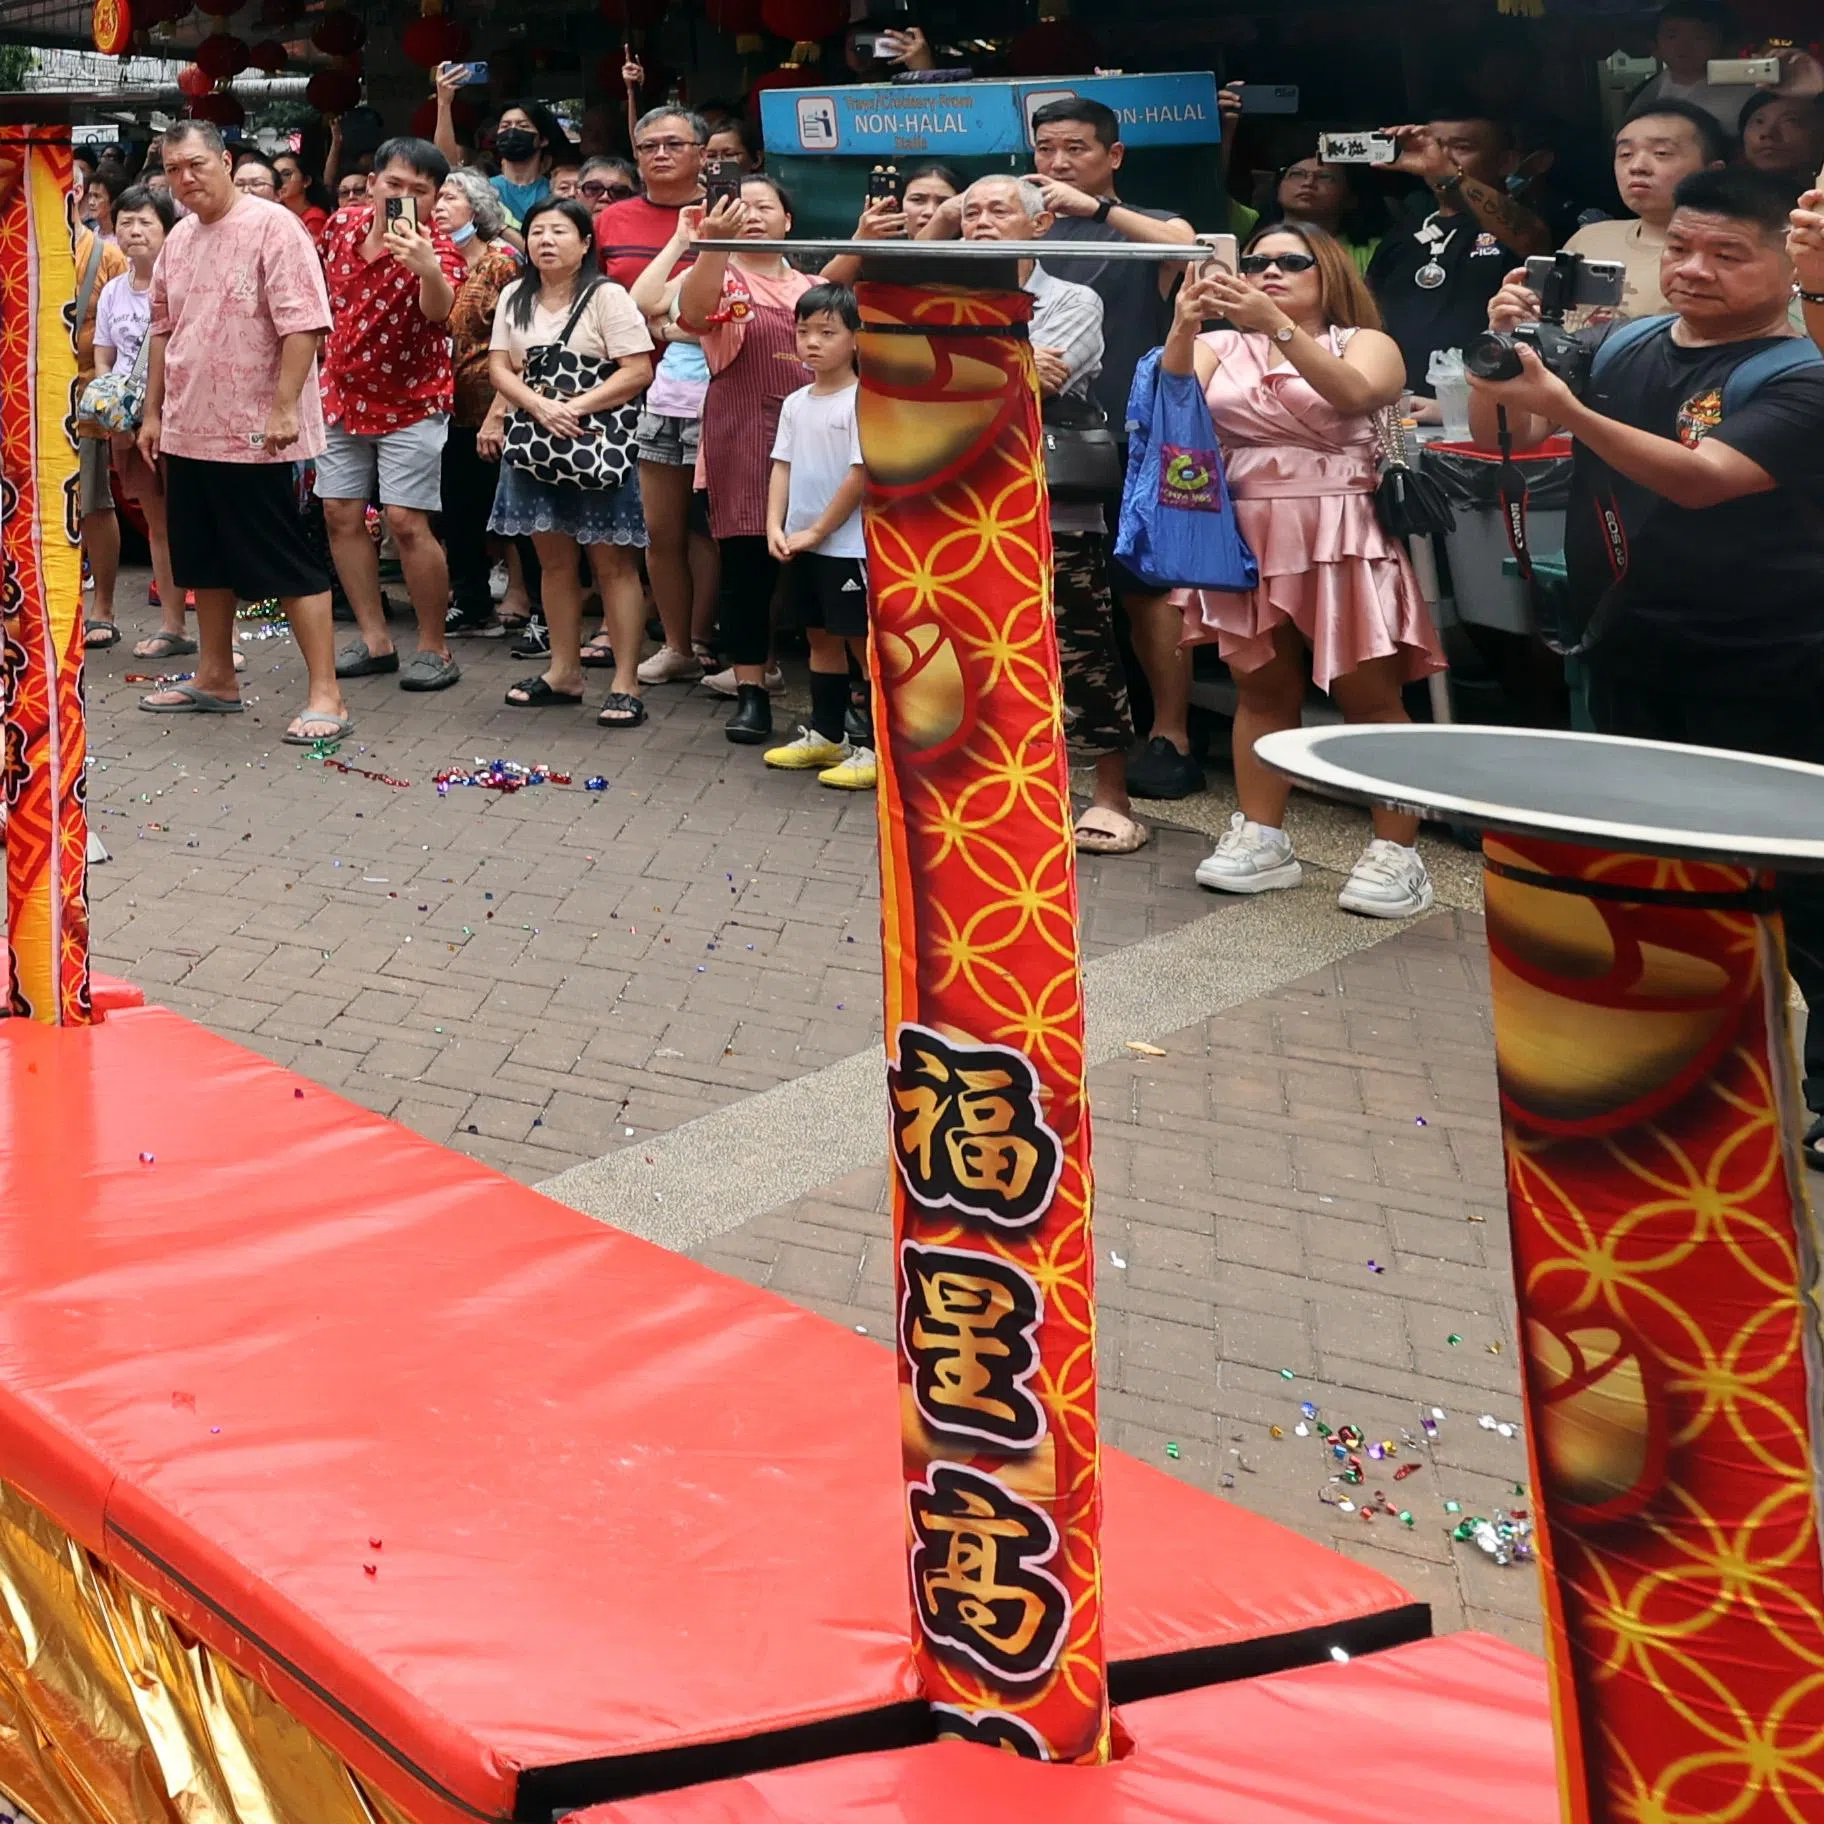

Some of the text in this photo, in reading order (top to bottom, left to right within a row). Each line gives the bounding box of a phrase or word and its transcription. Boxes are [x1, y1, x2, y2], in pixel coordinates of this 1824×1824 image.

[855, 112, 968, 134] NON-HALAL
[1113, 102, 1207, 125] ON-HALAL
[1510, 502, 1524, 549] Canon
[1604, 509, 1622, 545] EOS
[888, 1028, 1066, 1761] 福星高
